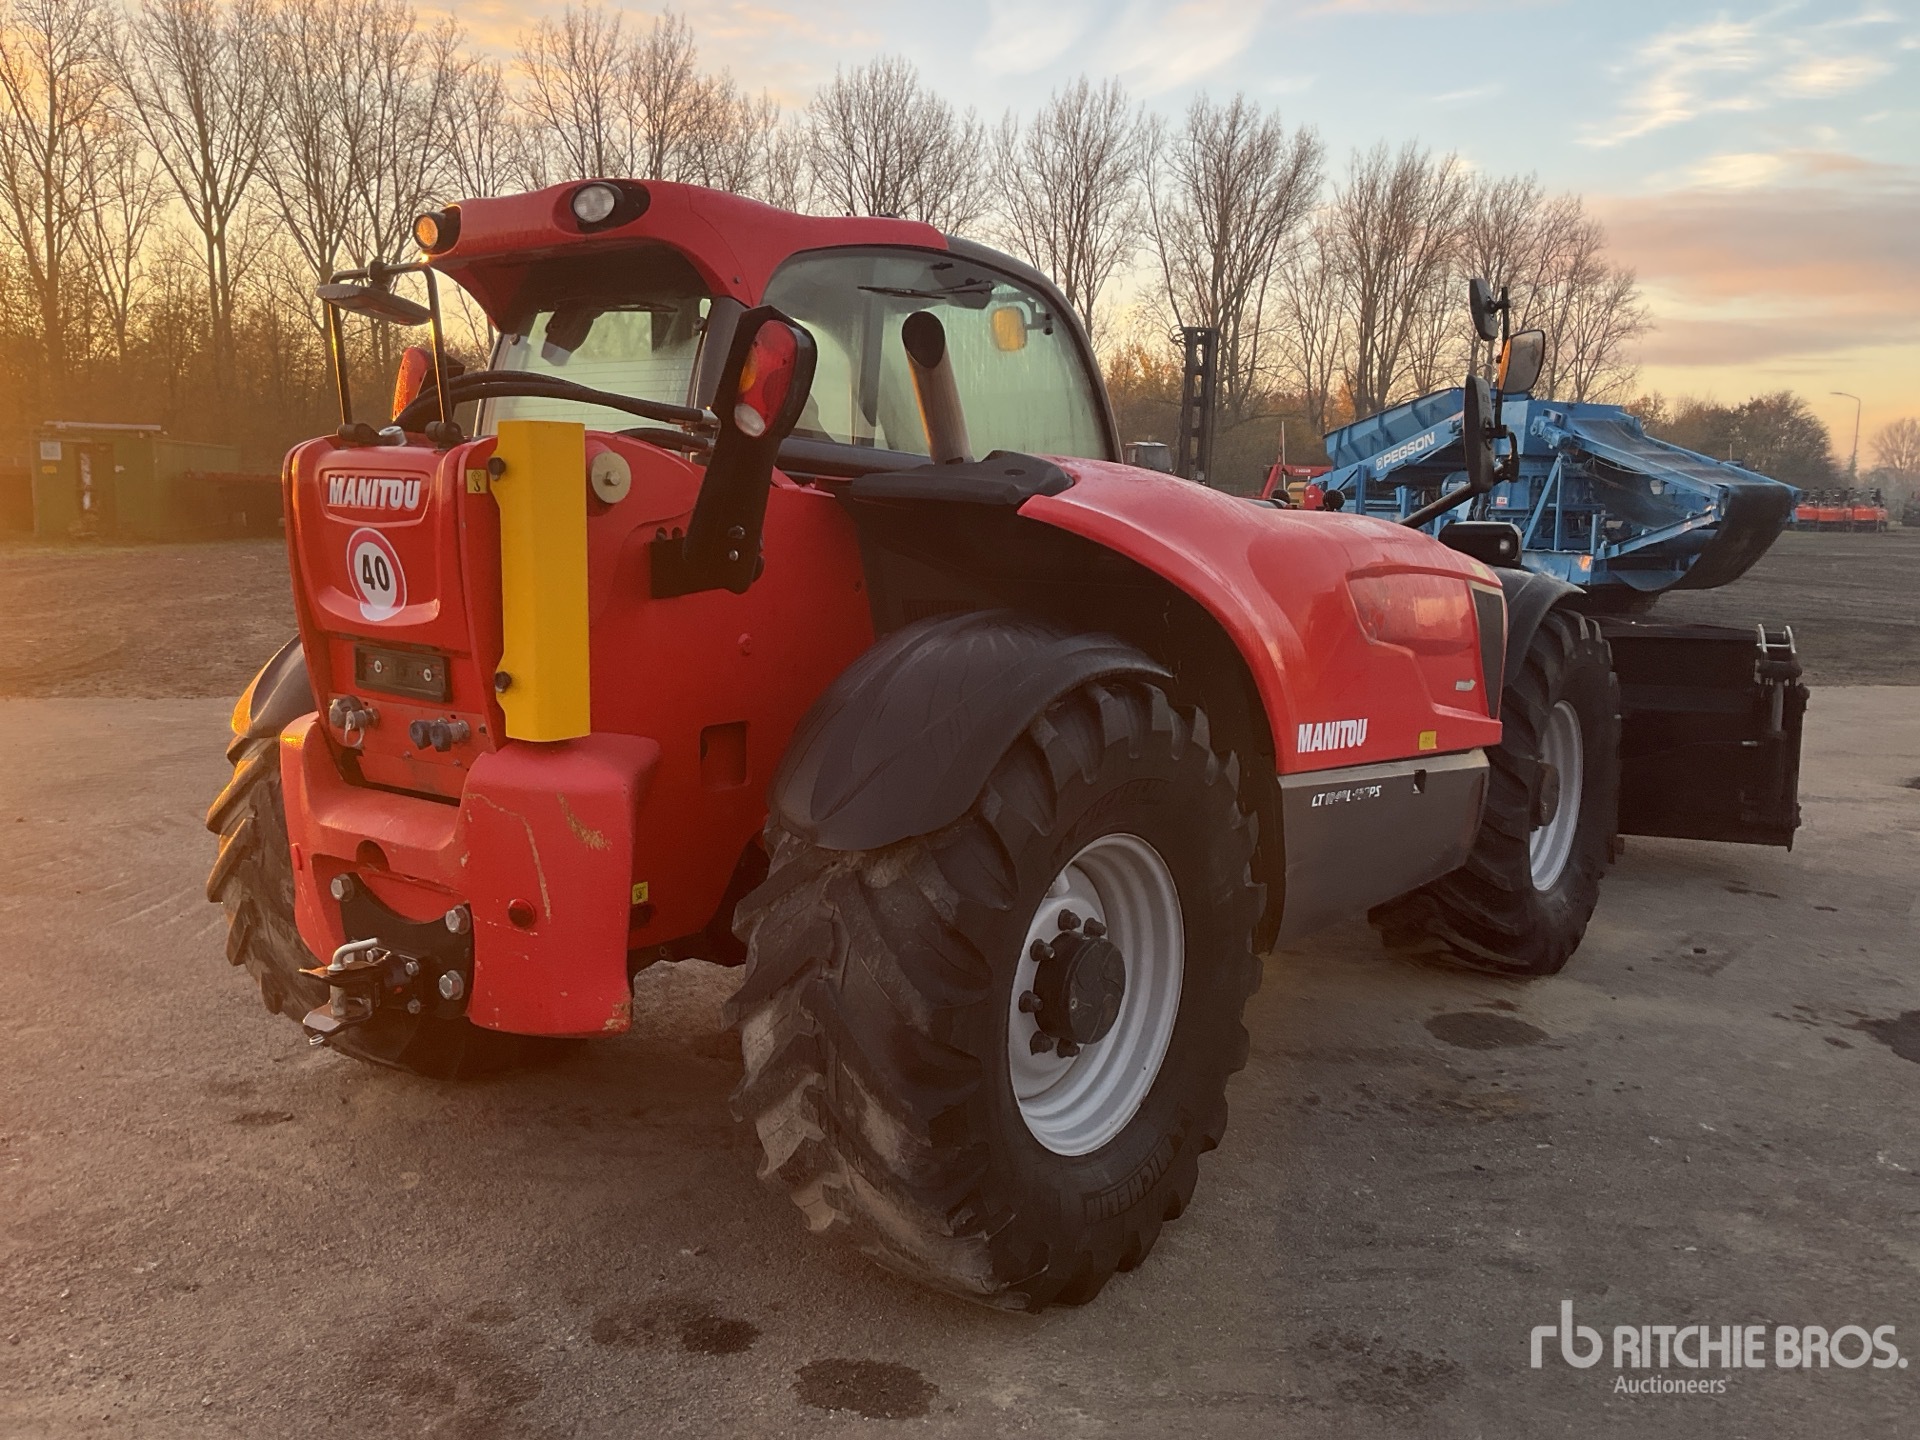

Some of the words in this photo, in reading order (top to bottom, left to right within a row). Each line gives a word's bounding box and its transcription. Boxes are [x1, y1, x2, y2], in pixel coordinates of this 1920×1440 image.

[1383, 431, 1436, 468] PEGSON
[329, 476, 421, 509] MANITOU
[362, 554, 391, 592] 40
[1297, 718, 1368, 753] MANITOU
